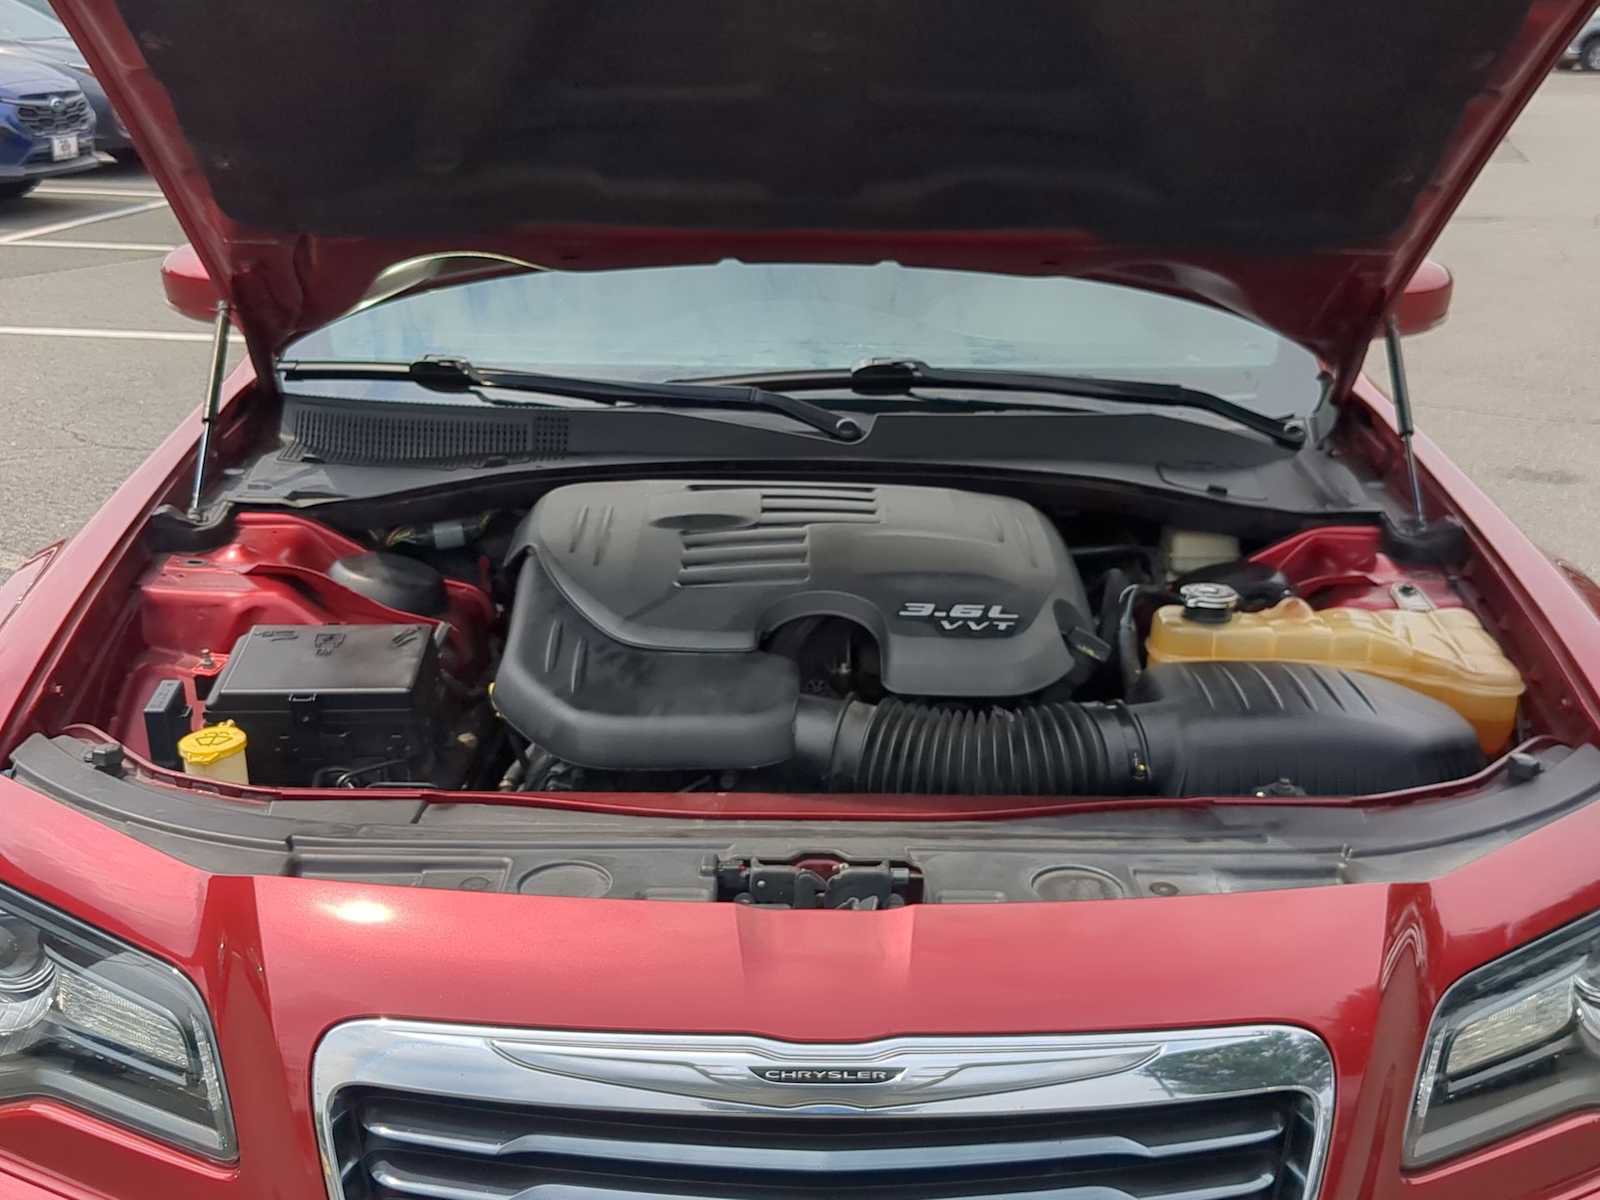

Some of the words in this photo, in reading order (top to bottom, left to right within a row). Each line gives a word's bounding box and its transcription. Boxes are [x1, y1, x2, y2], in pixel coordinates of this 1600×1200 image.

[898, 602, 1019, 618] 3.6L
[940, 620, 1015, 631] VVT
[765, 1070, 888, 1080] CHRYSLER
